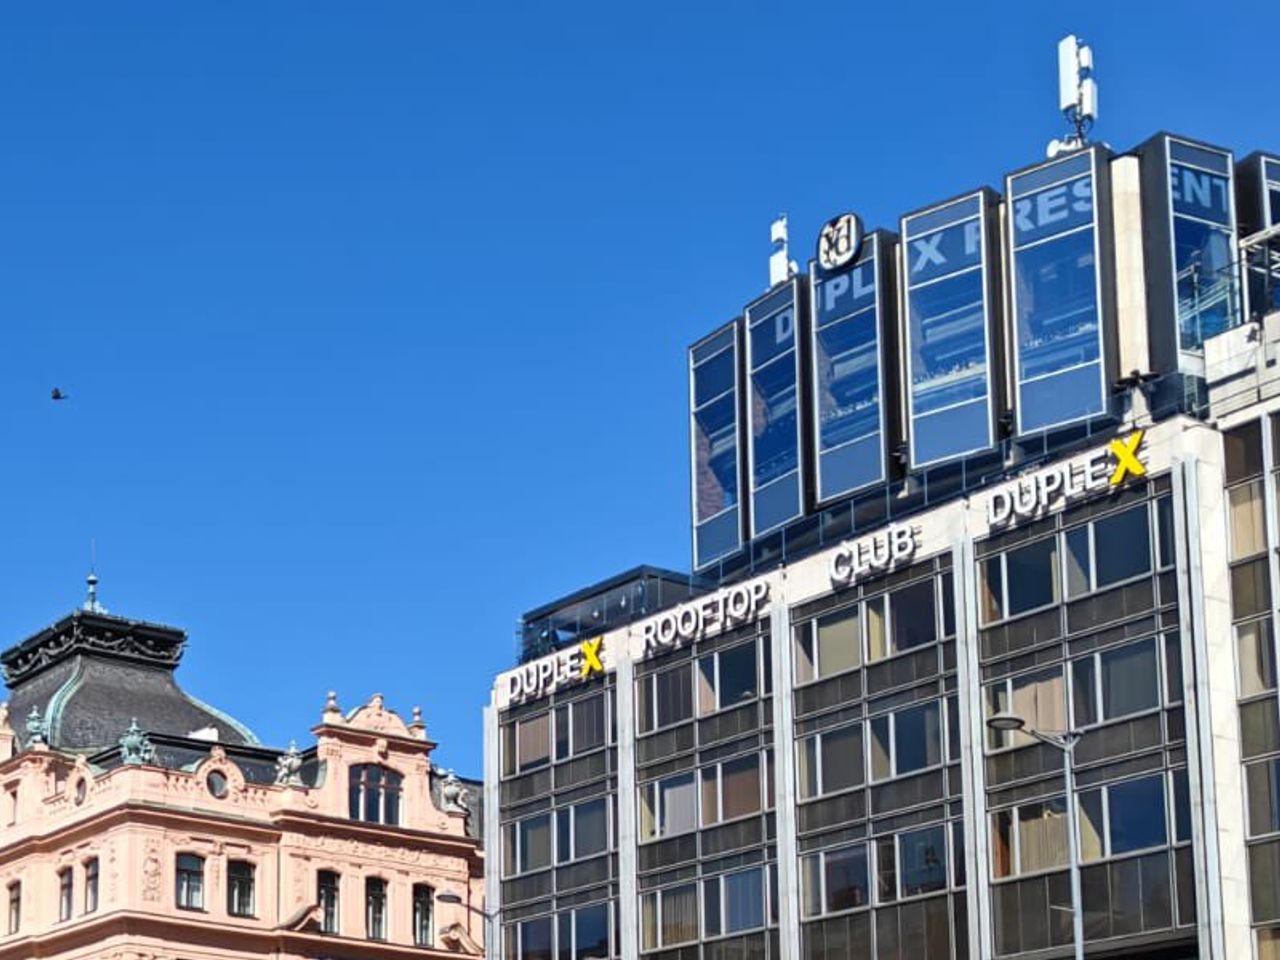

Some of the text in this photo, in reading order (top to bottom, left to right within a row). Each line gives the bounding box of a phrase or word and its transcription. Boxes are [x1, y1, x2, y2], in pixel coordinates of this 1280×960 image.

[988, 429, 1146, 524] DUPLEX
[507, 524, 915, 699] DUPLEX ROOFTOP CLUB
